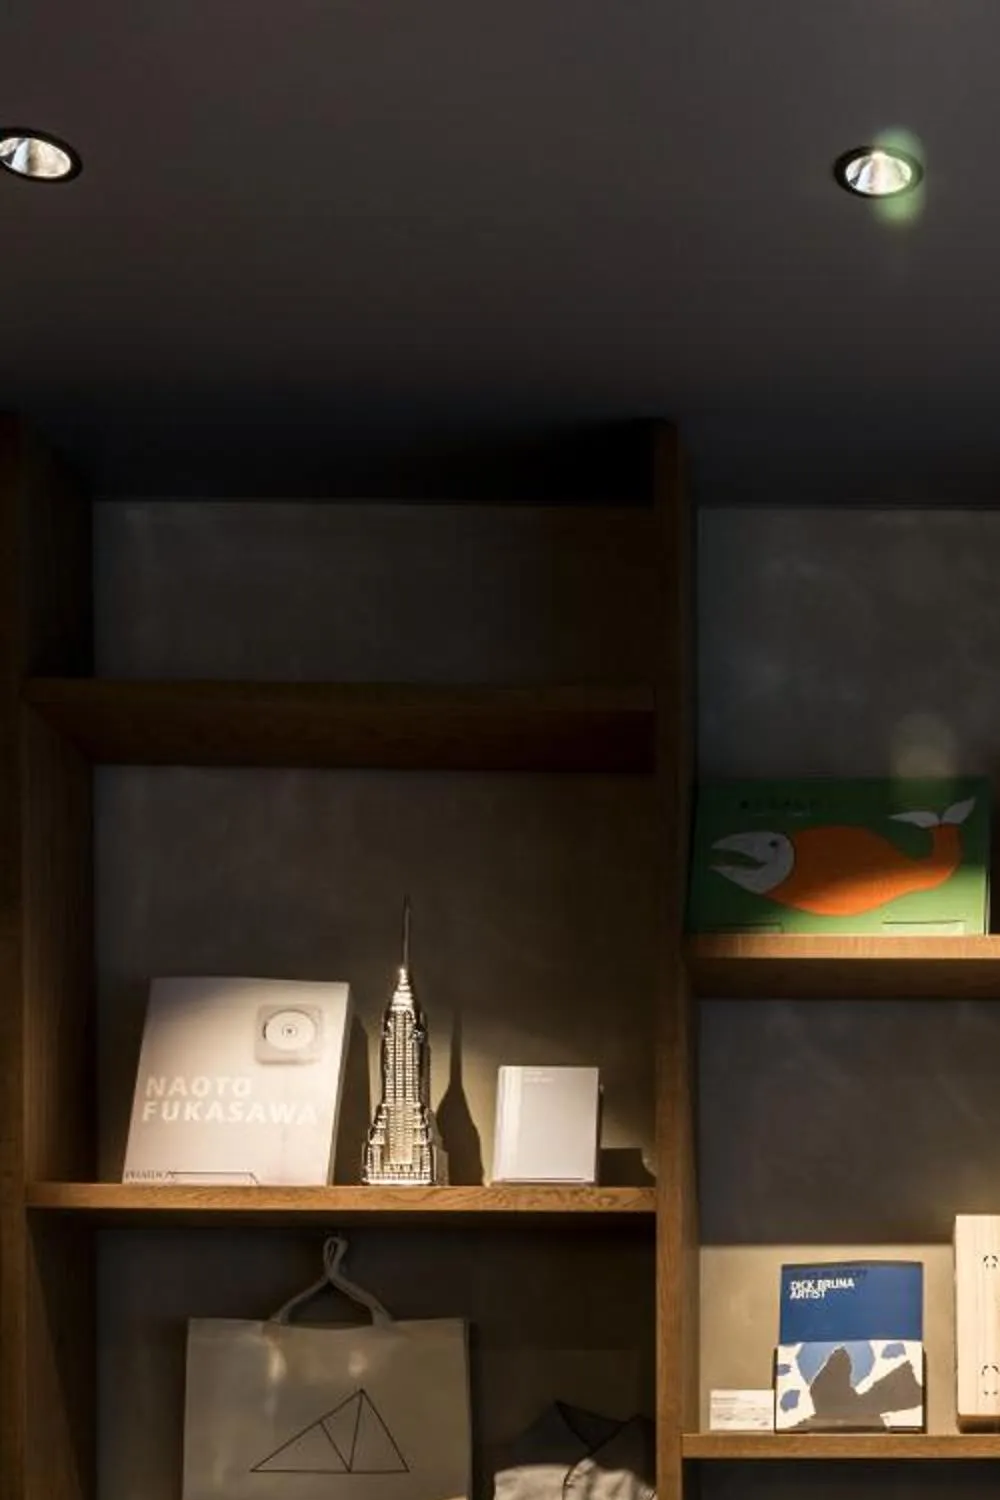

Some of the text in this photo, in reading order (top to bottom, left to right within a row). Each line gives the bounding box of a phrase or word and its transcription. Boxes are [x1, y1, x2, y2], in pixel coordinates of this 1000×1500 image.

[146, 1076, 253, 1097] NAOTO
[142, 1100, 318, 1125] FUKASAWA
[790, 1280, 814, 1291] DICK
[790, 1289, 825, 1299] ARTIST
